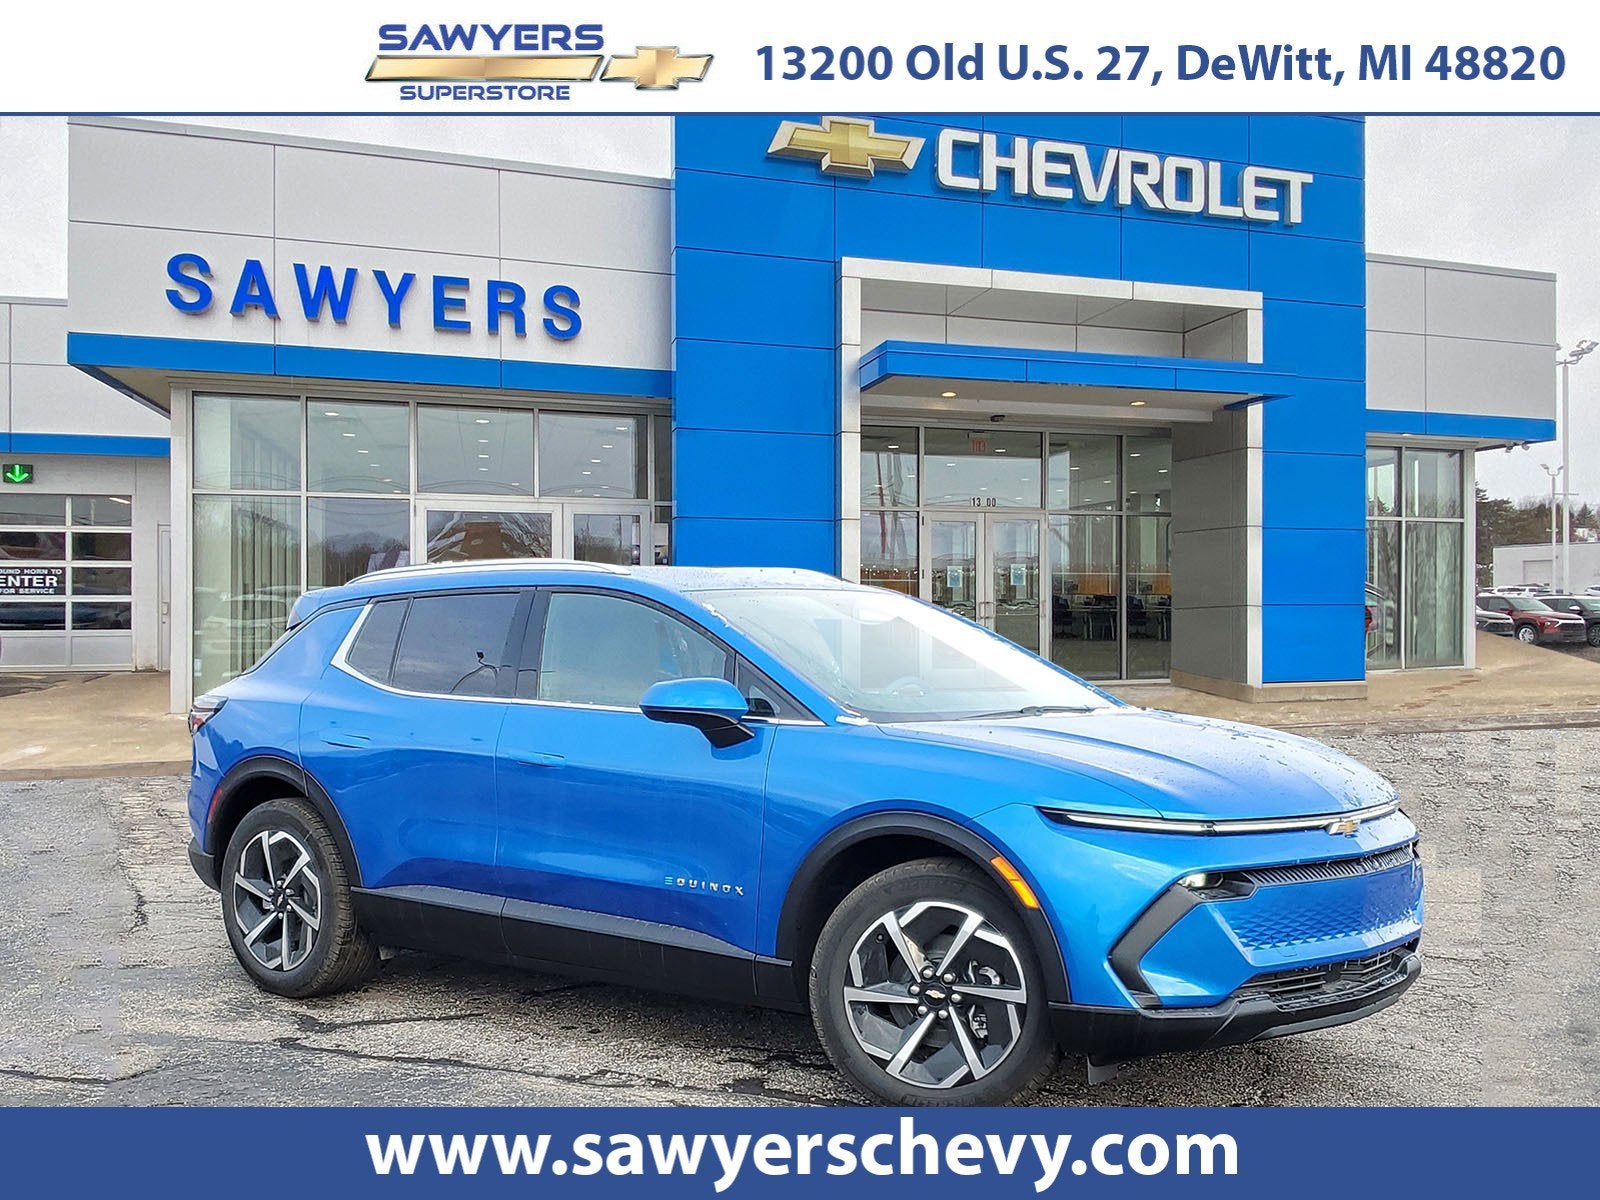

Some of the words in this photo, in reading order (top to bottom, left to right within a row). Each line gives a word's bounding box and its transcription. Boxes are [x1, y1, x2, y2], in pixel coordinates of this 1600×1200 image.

[935, 128, 1313, 225] CHEVROLET
[165, 252, 582, 342] SAWYERS
[664, 876, 744, 896] EQUINOX
